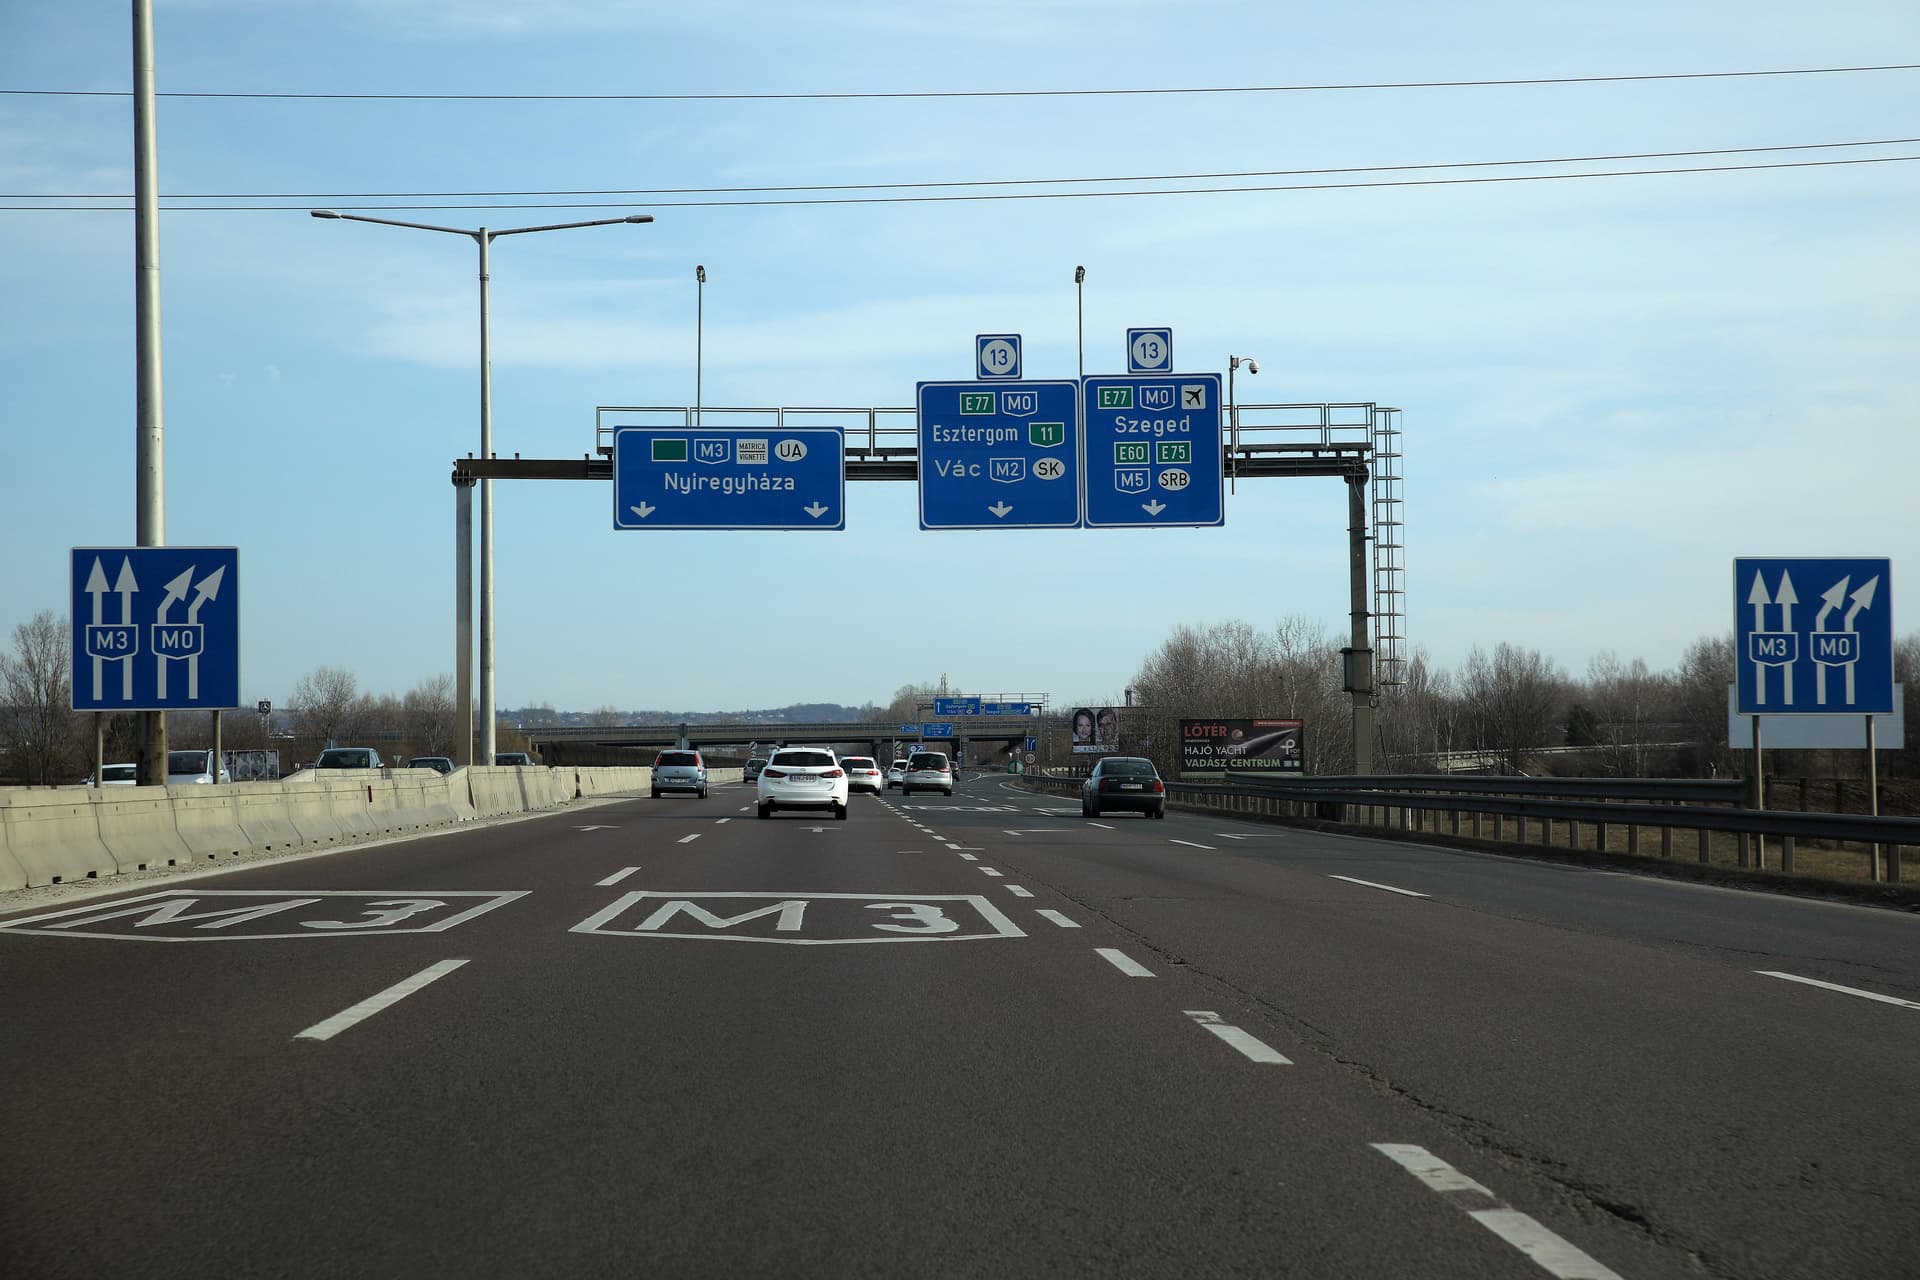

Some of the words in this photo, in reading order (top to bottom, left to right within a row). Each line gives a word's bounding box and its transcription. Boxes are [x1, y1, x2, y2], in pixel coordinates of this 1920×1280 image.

[990, 348, 1008, 366] 13
[1140, 342, 1159, 360] 13
[1007, 397, 1031, 411] M0
[1145, 390, 1169, 404] M0
[1114, 415, 1190, 437] Szeged
[932, 424, 1018, 446] Esztergom
[1040, 427, 1054, 442] 11
[700, 443, 724, 458] M3
[738, 442, 766, 450] MATRICA
[779, 443, 802, 458] UA
[738, 453, 766, 461] VIGNETTE
[934, 459, 981, 477] Vác
[995, 462, 1019, 477] M2
[1037, 461, 1060, 476] SK
[1121, 472, 1144, 487] M5
[1160, 472, 1188, 487] SRB
[96, 630, 128, 650] M3
[161, 630, 193, 649] M0
[1758, 638, 1787, 657] M3
[1820, 638, 1850, 656] M0
[1184, 744, 1213, 755] HAJÓ
[1216, 746, 1248, 755] YACHT
[1185, 756, 1227, 768] VADÁSZ
[1230, 758, 1281, 768] CENTRUM
